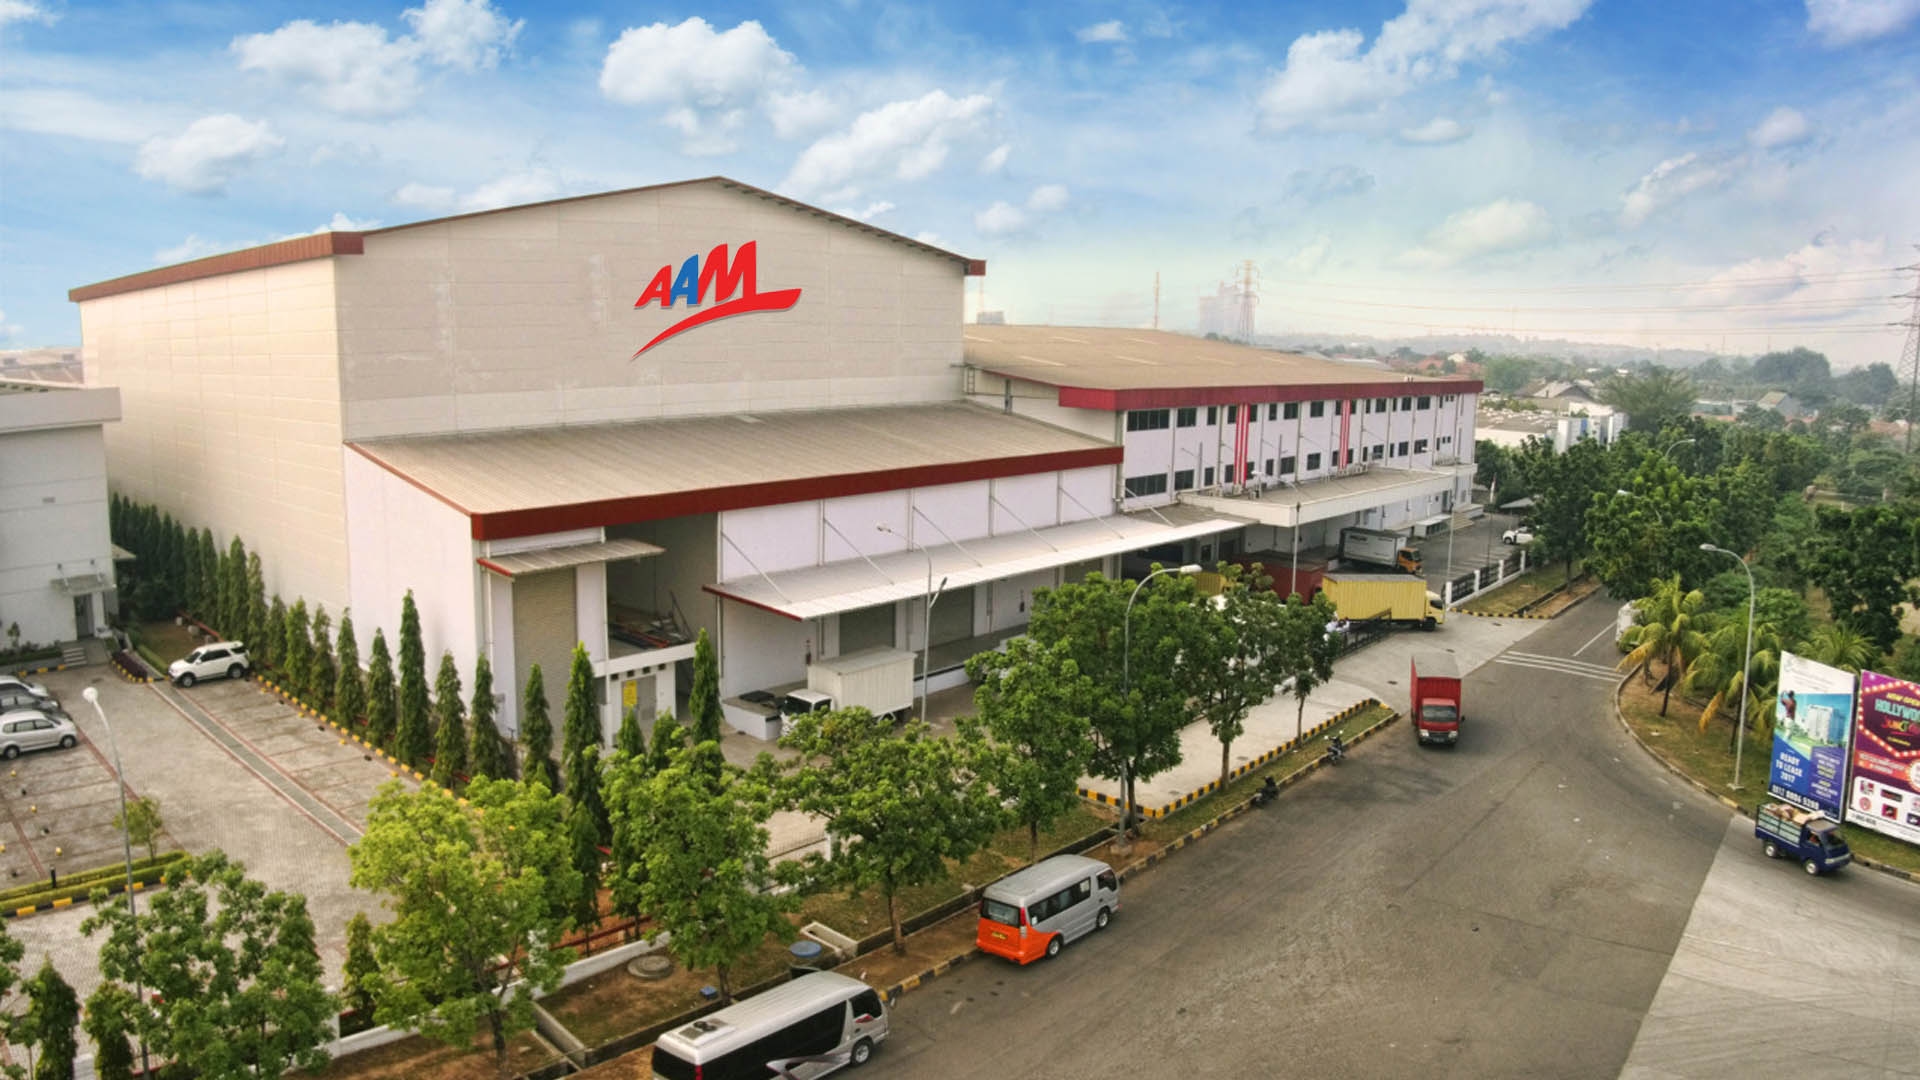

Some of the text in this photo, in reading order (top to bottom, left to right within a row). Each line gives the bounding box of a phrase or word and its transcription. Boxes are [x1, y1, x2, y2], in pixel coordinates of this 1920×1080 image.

[634, 240, 757, 308] AAM
[1780, 752, 1800, 766] READY
[1776, 759, 1784, 769] TO
[1783, 763, 1803, 777] LEASE
[1780, 771, 1795, 783] 2017
